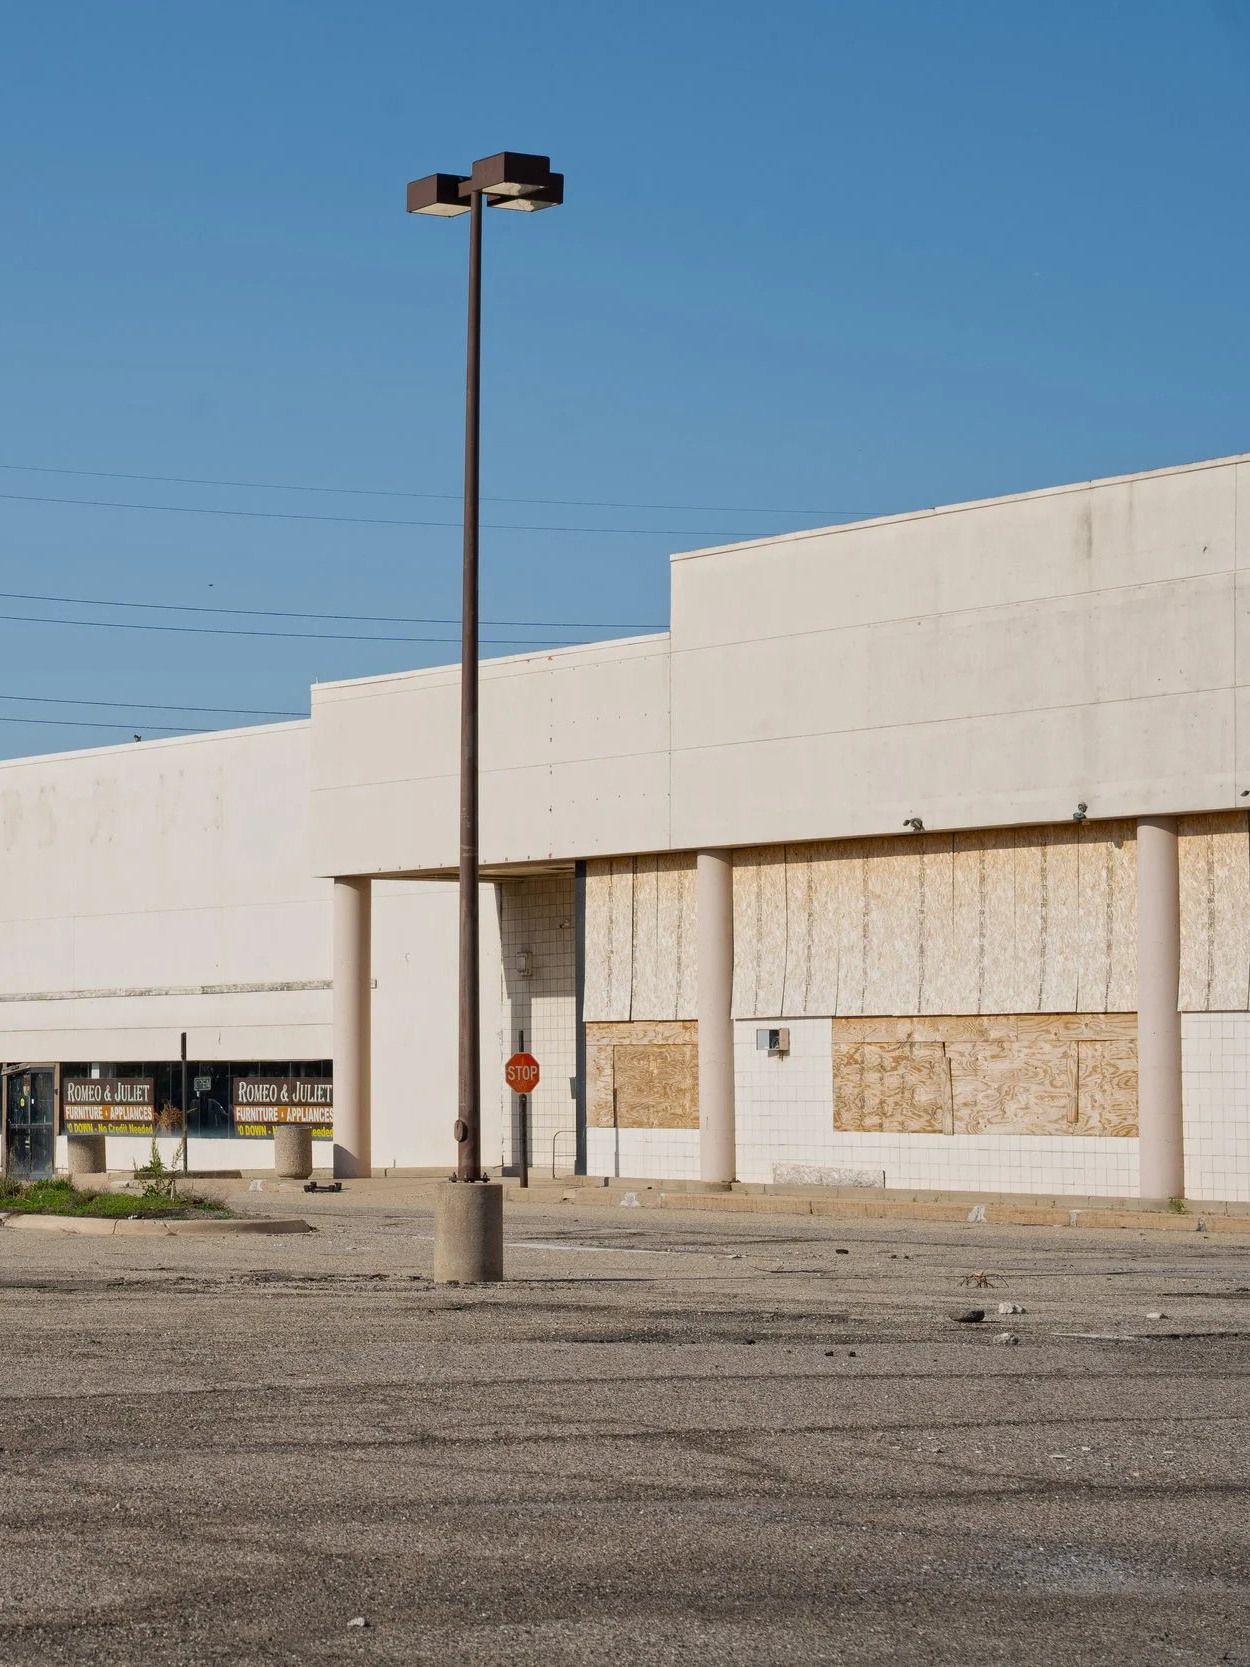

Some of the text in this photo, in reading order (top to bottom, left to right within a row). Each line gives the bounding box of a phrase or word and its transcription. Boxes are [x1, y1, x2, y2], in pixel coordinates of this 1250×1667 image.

[507, 1065, 538, 1081] STOP
[195, 1078, 210, 1089] OPEN
[103, 1084, 112, 1102] &
[280, 1083, 290, 1102] &
[65, 1106, 104, 1120] FURNITURE
[110, 1106, 153, 1121] APPLIANCES
[236, 1107, 279, 1122] FURNITURE
[286, 1107, 334, 1122] APPLIANCES
[74, 1123, 93, 1133] DOWN
[98, 1124, 108, 1133] No
[108, 1124, 128, 1134] Credit
[129, 1124, 153, 1134] Needed
[245, 1125, 267, 1136] DOWN
